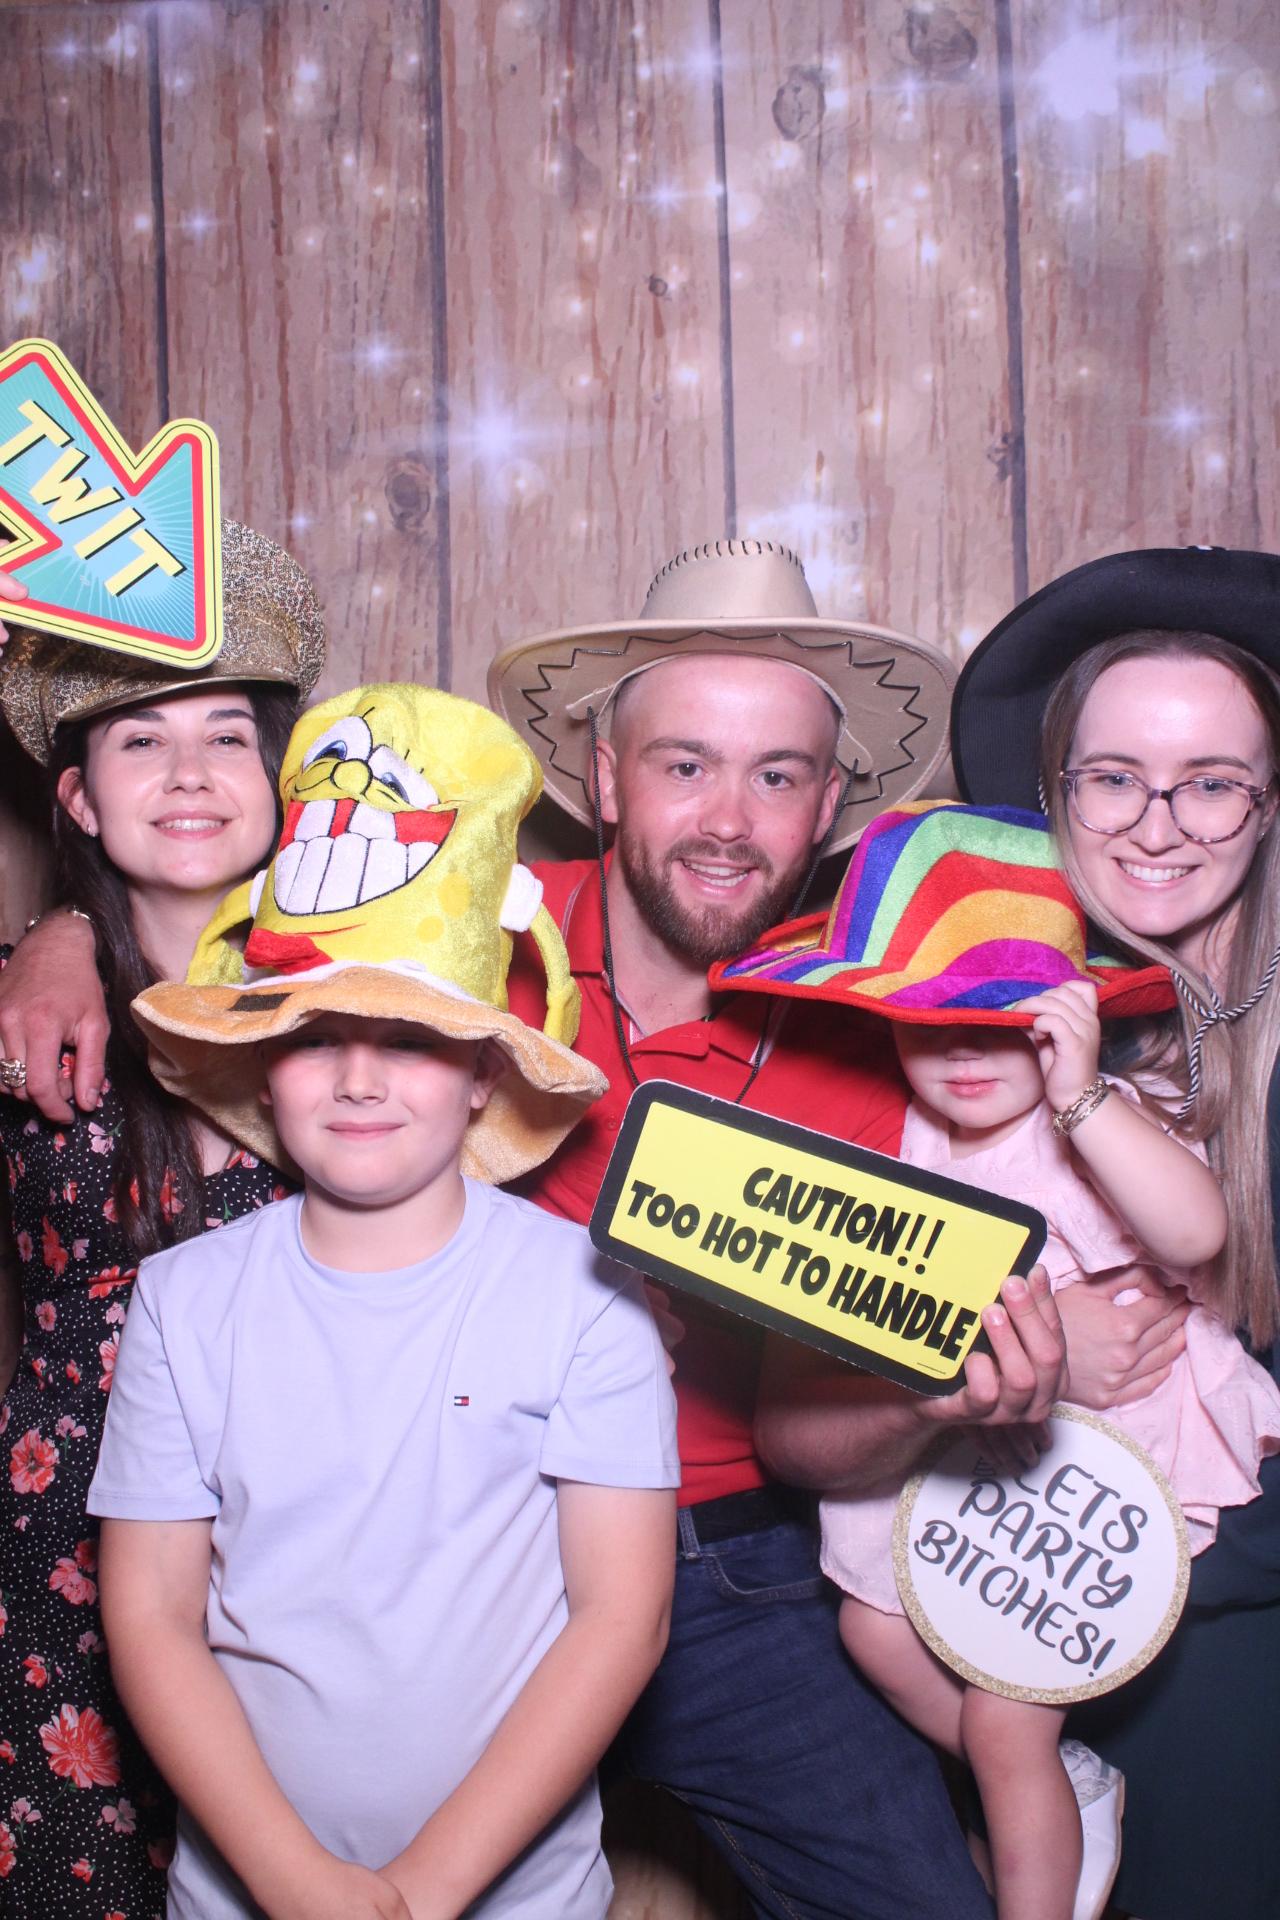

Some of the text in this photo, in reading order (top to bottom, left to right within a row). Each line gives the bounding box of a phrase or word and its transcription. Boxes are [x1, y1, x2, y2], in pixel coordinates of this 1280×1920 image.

[0, 399, 187, 597] TWIT
[627, 1180, 979, 1361] TOO HOT TO HANDLE
[742, 1167, 946, 1275] CAUTION!!
[914, 1519, 1116, 1677] BITCHES!
[958, 1477, 1133, 1609] PARTY
